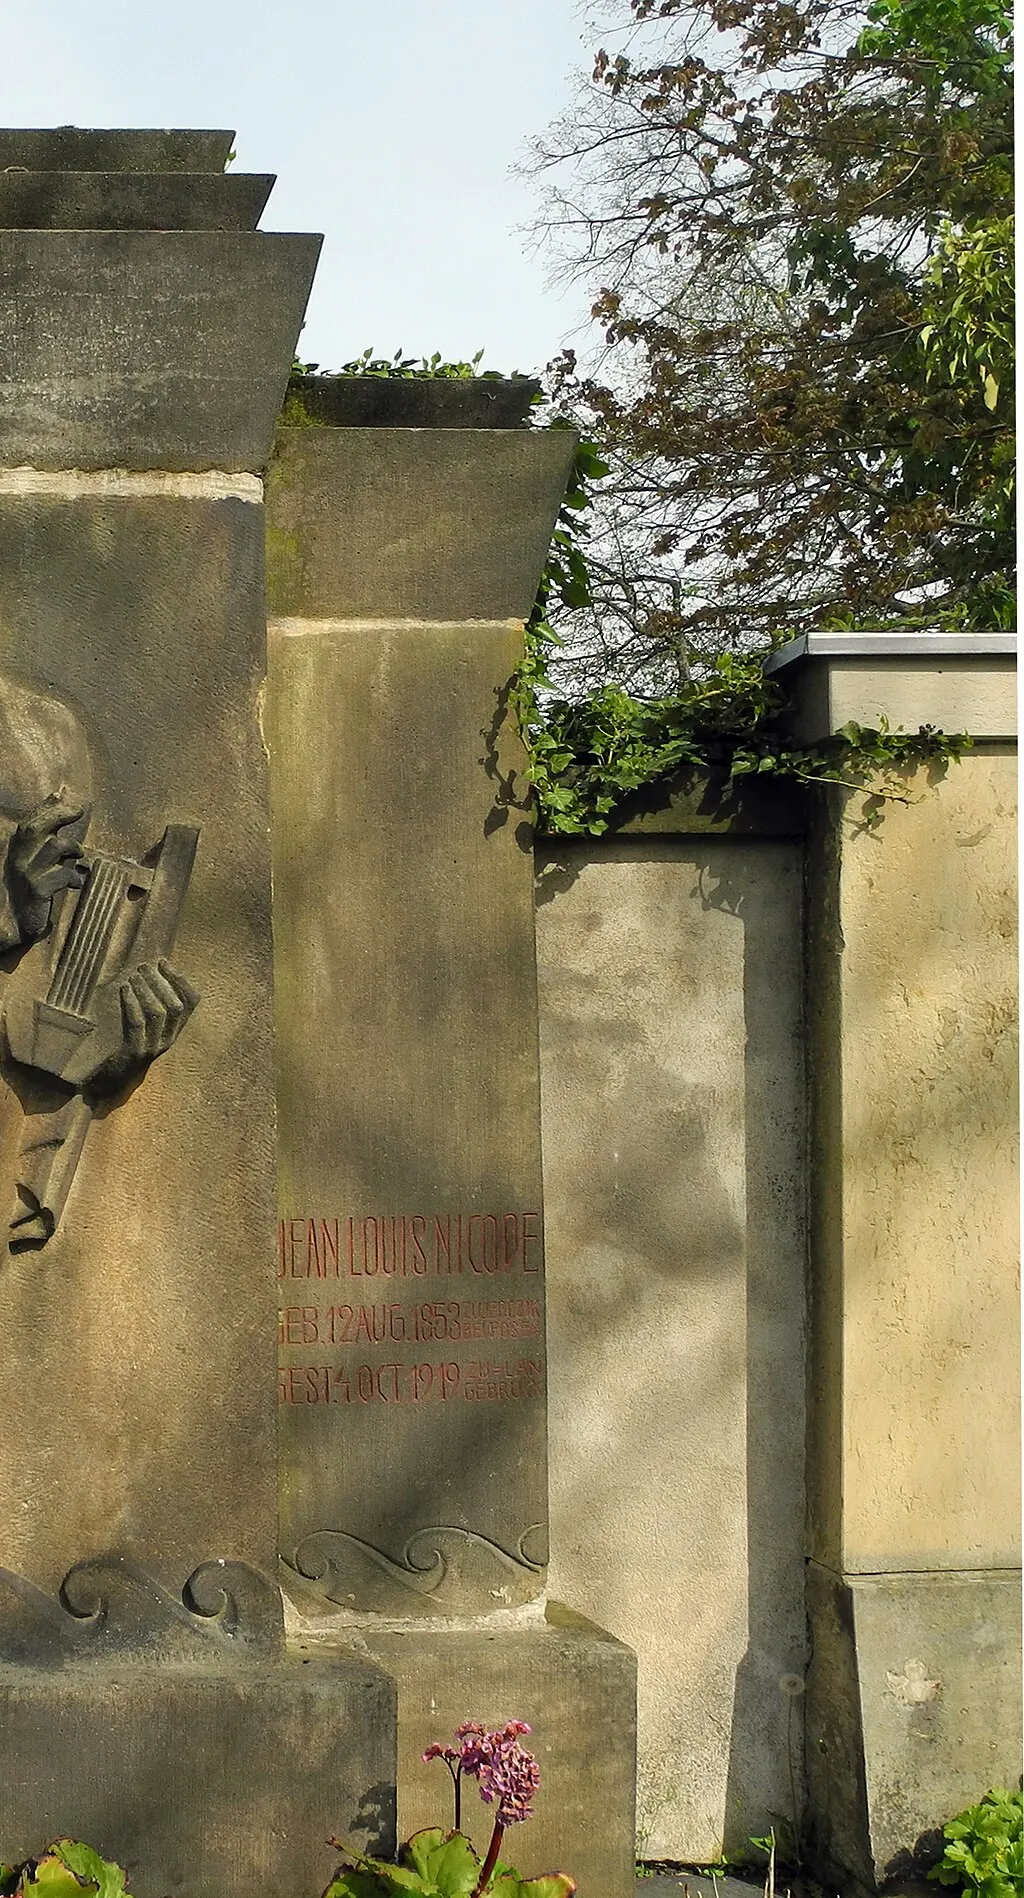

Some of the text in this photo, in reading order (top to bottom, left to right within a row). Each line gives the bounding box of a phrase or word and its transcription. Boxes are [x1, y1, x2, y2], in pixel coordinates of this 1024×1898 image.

[277, 1212, 538, 1279] JEAN LOUIS NICODE
[413, 1302, 461, 1342] 1853
